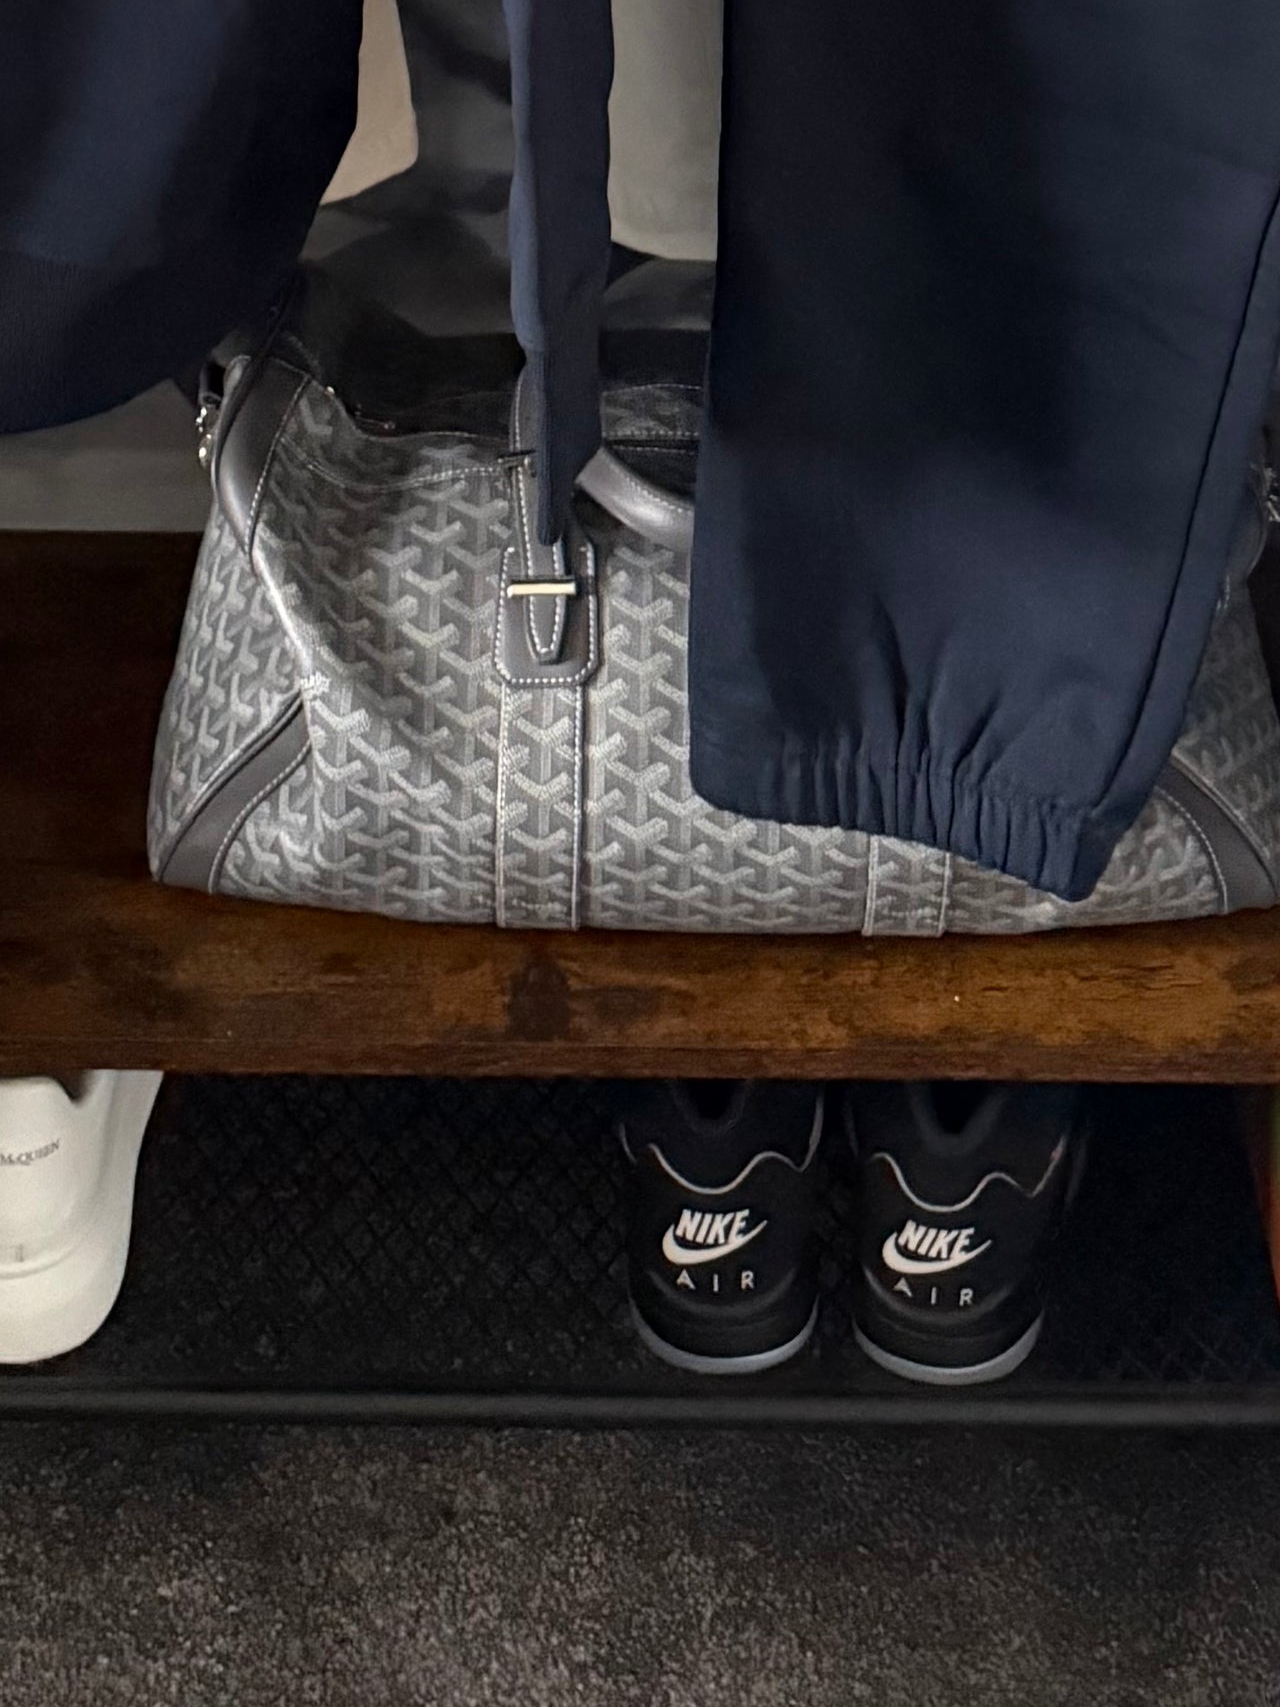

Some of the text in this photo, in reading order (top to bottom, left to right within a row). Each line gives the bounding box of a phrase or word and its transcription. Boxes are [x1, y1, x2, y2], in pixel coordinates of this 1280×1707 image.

[674, 1208, 751, 1246] NIKE
[896, 1219, 976, 1260] NIKE
[676, 1268, 755, 1293] AIR
[893, 1277, 974, 1307] AIR
